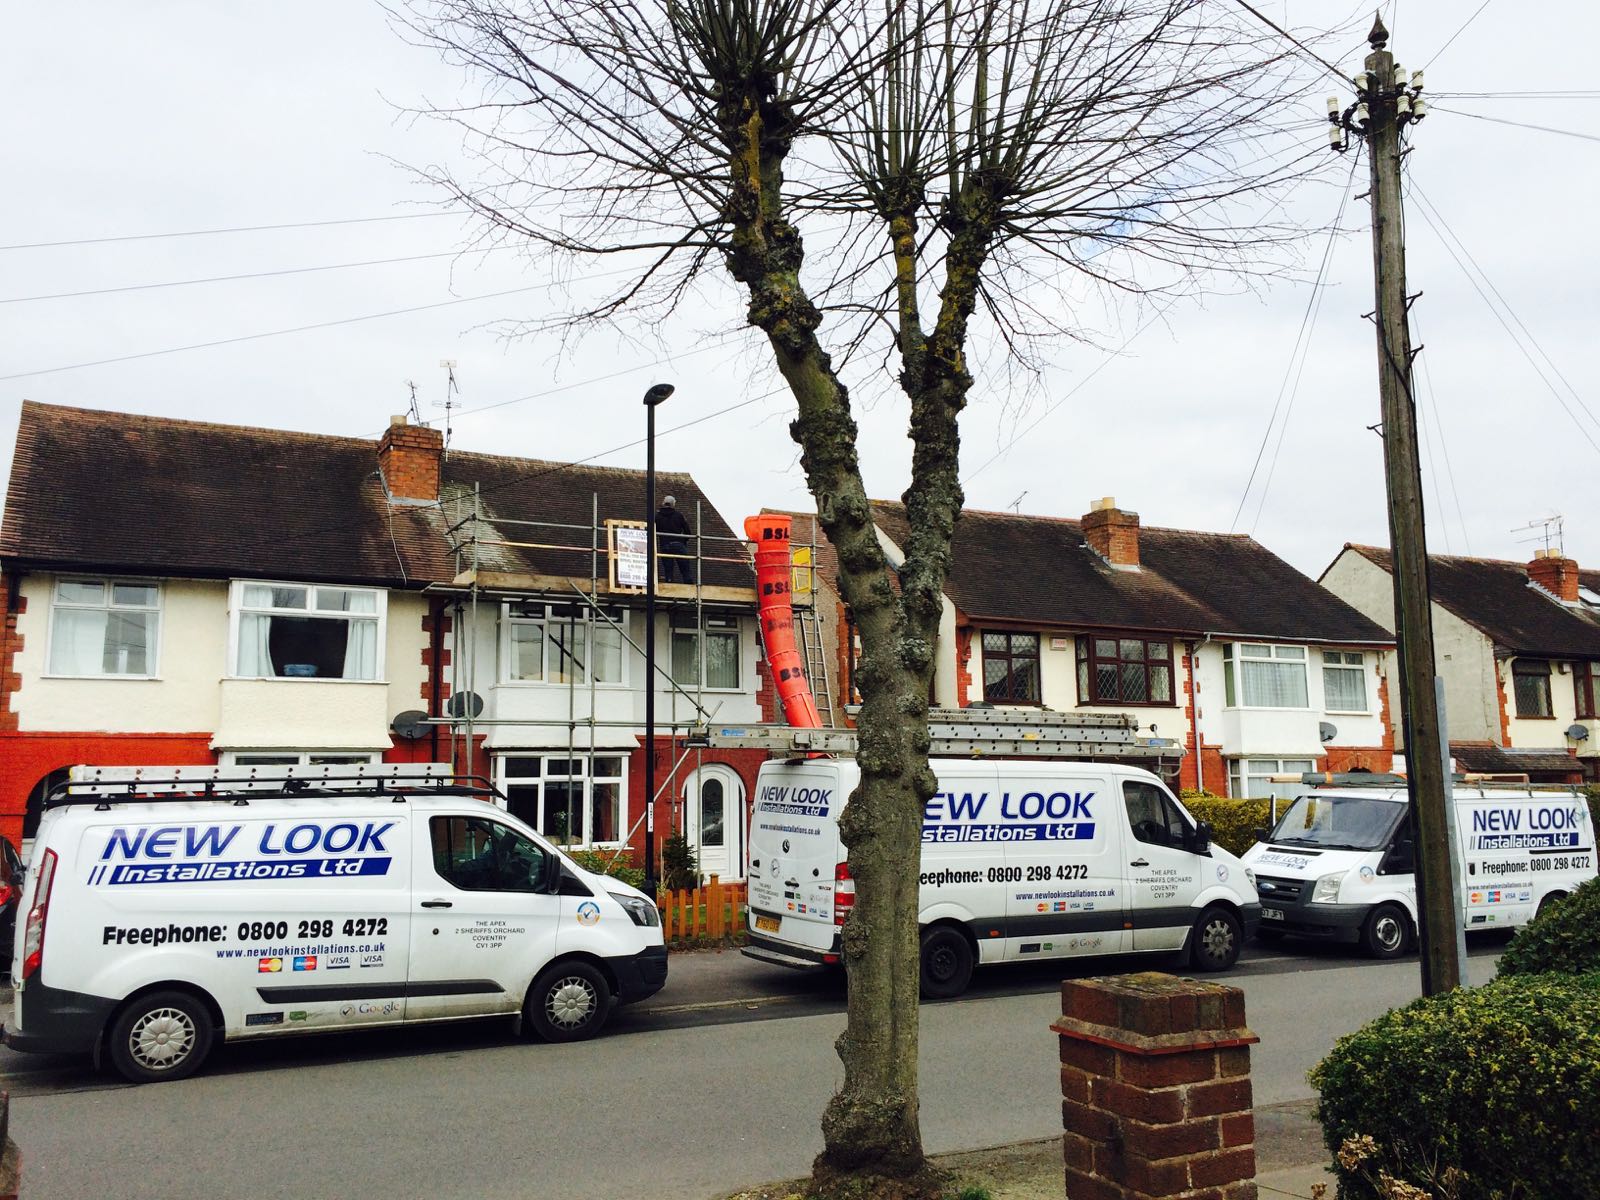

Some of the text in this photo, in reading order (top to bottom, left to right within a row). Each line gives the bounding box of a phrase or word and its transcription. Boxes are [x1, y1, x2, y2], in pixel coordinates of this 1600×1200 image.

[763, 527, 789, 539] BSL
[760, 786, 832, 805] NEW LOOK
[761, 802, 821, 816] Installations Ltd
[924, 792, 1095, 820] EW LOOK
[1473, 808, 1577, 832] NEW LOOK
[101, 822, 396, 861] NEW LOOK
[921, 824, 1077, 842] stallations Ltd
[1480, 833, 1570, 849] Installations Ltd
[117, 858, 365, 882] Installations Ltd
[1482, 856, 1590, 876] Freephone: 0800 298 4272
[919, 865, 1088, 888] eephone: 0800 298 4272
[1015, 888, 1115, 900] www.newlookinstallations.co.uk
[103, 918, 388, 947] Freephone: 0800 298 4272
[216, 942, 386, 958] www.newlookinstallations.co.uk
[363, 955, 382, 963] VISA
[330, 956, 349, 965] VISA
[359, 1001, 400, 1015] Google
